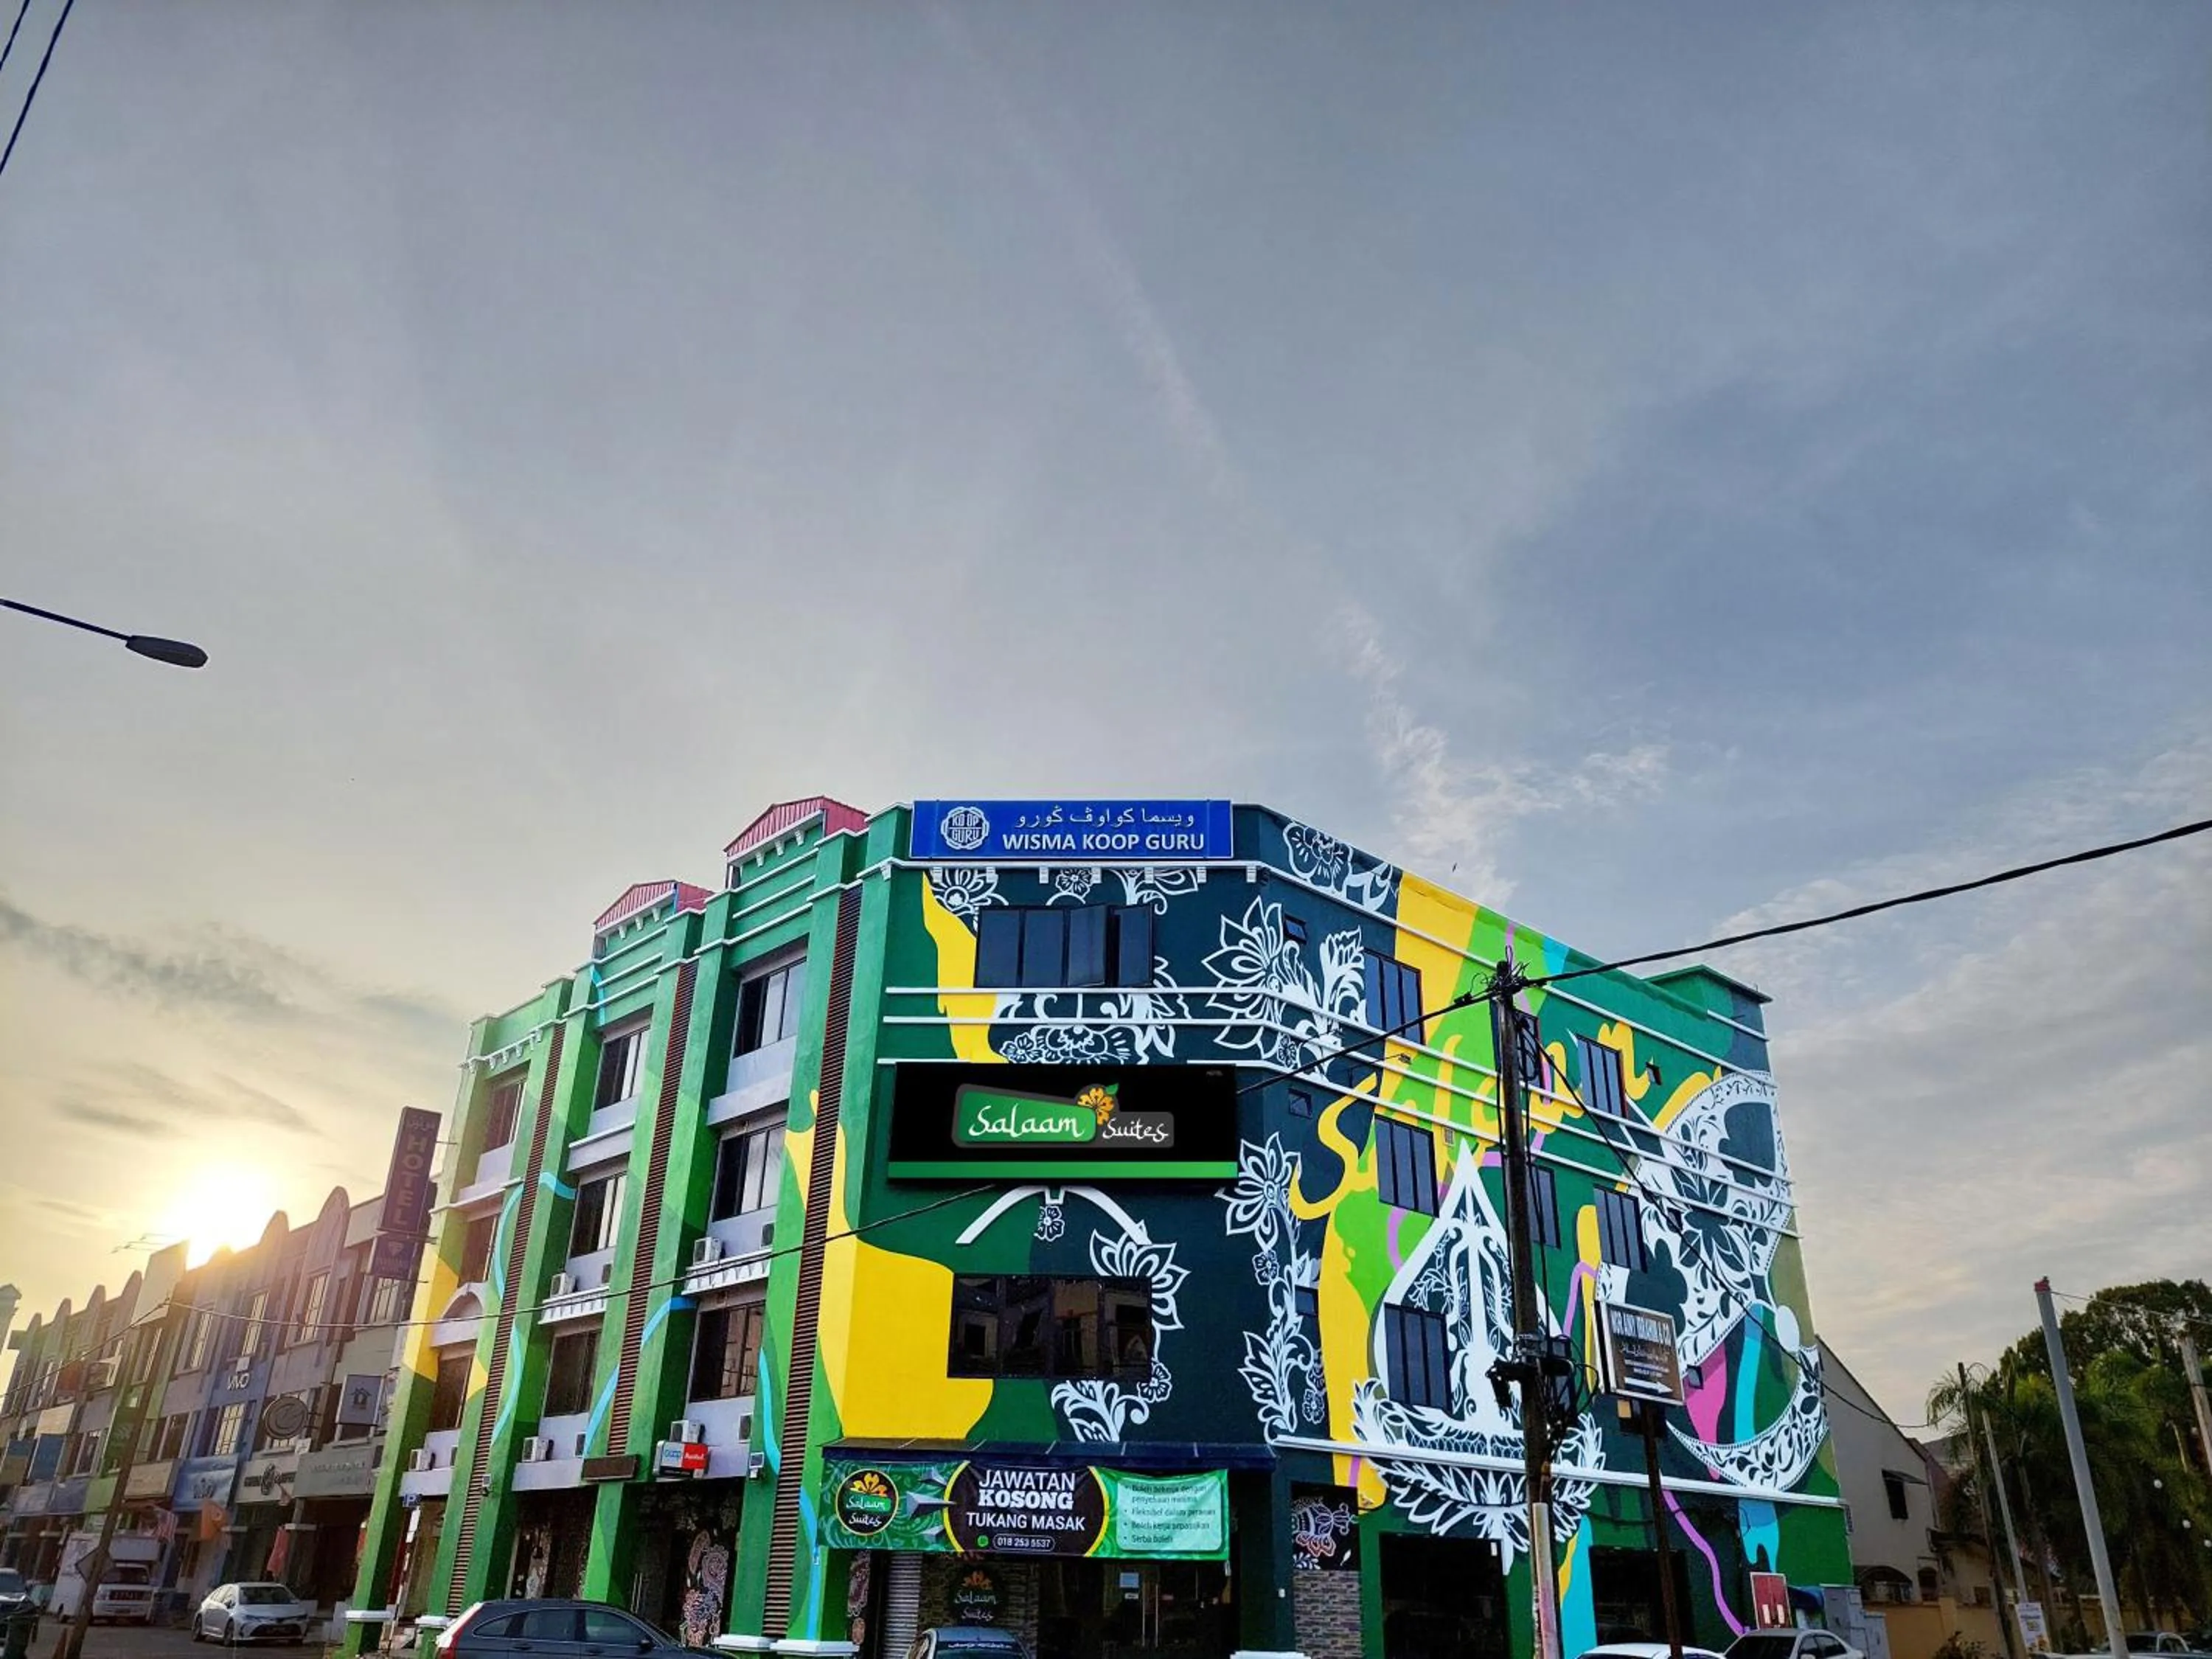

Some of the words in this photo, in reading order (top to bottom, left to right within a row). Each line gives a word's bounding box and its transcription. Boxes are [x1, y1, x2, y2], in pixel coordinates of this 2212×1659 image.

[952, 829, 980, 844] GURU
[1002, 834, 1076, 850] WISMA
[1082, 834, 1140, 850] KOOP
[1145, 834, 1205, 850] GURU
[968, 1103, 1085, 1138] Salaam
[1102, 1117, 1169, 1143] Suites
[392, 1134, 428, 1225] HOTEL
[978, 1470, 1076, 1491] JAWATAN
[846, 1495, 886, 1510] Salaam
[978, 1489, 1074, 1510] KOSONG
[849, 1512, 883, 1527] Suites
[967, 1512, 1027, 1529] TUKANG
[1032, 1515, 1085, 1531] MASAK
[997, 1537, 1012, 1546] 018
[1014, 1537, 1029, 1547] 253
